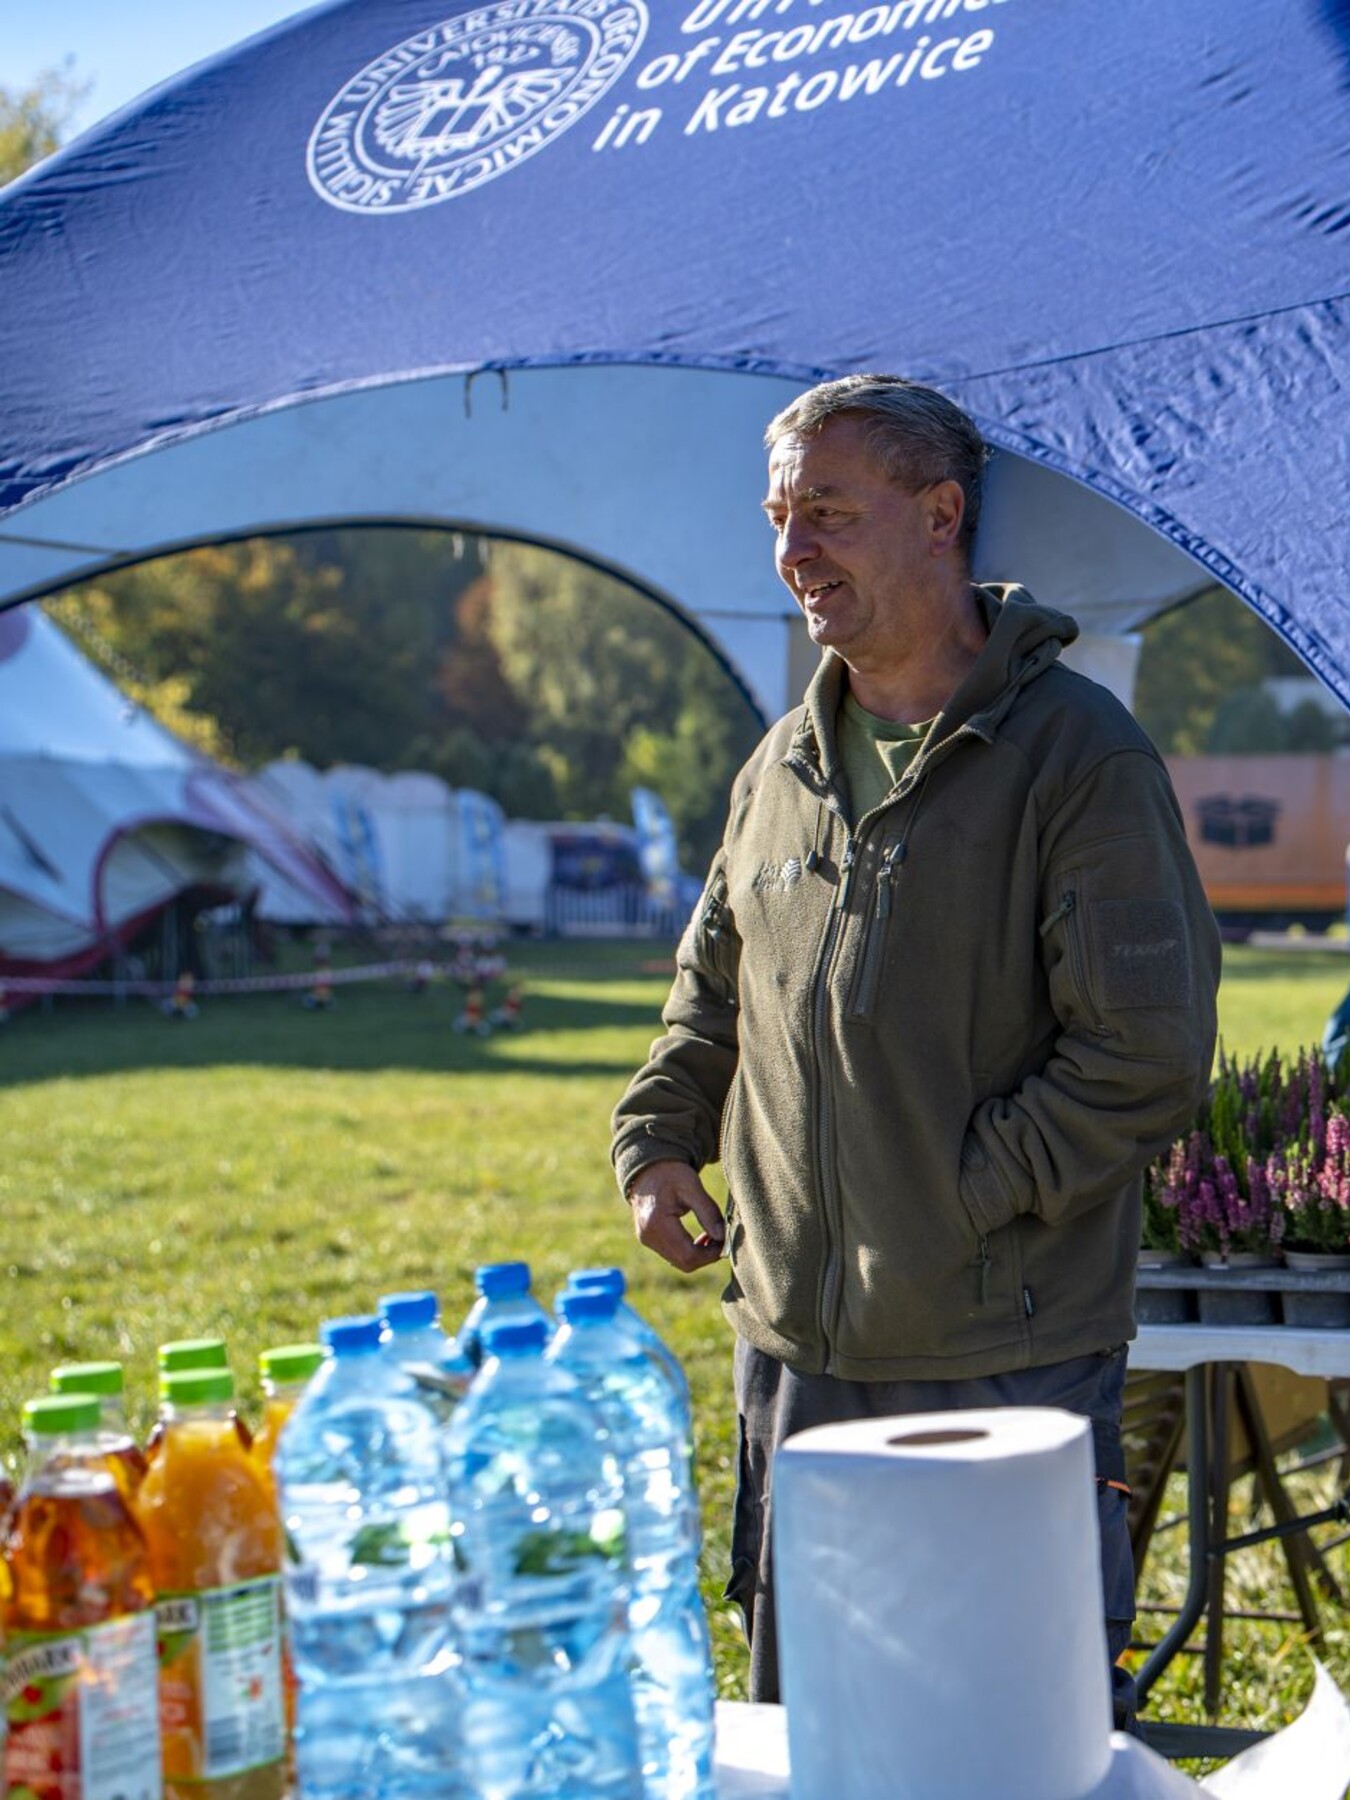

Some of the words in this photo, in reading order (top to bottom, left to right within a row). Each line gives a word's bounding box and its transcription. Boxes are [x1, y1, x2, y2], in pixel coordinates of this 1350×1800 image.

[592, 104, 662, 152] in
[683, 29, 995, 135] Katowice
[635, 37, 721, 90] of
[709, 0, 1008, 75] Econom
[316, 110, 402, 207] SIGILLUM
